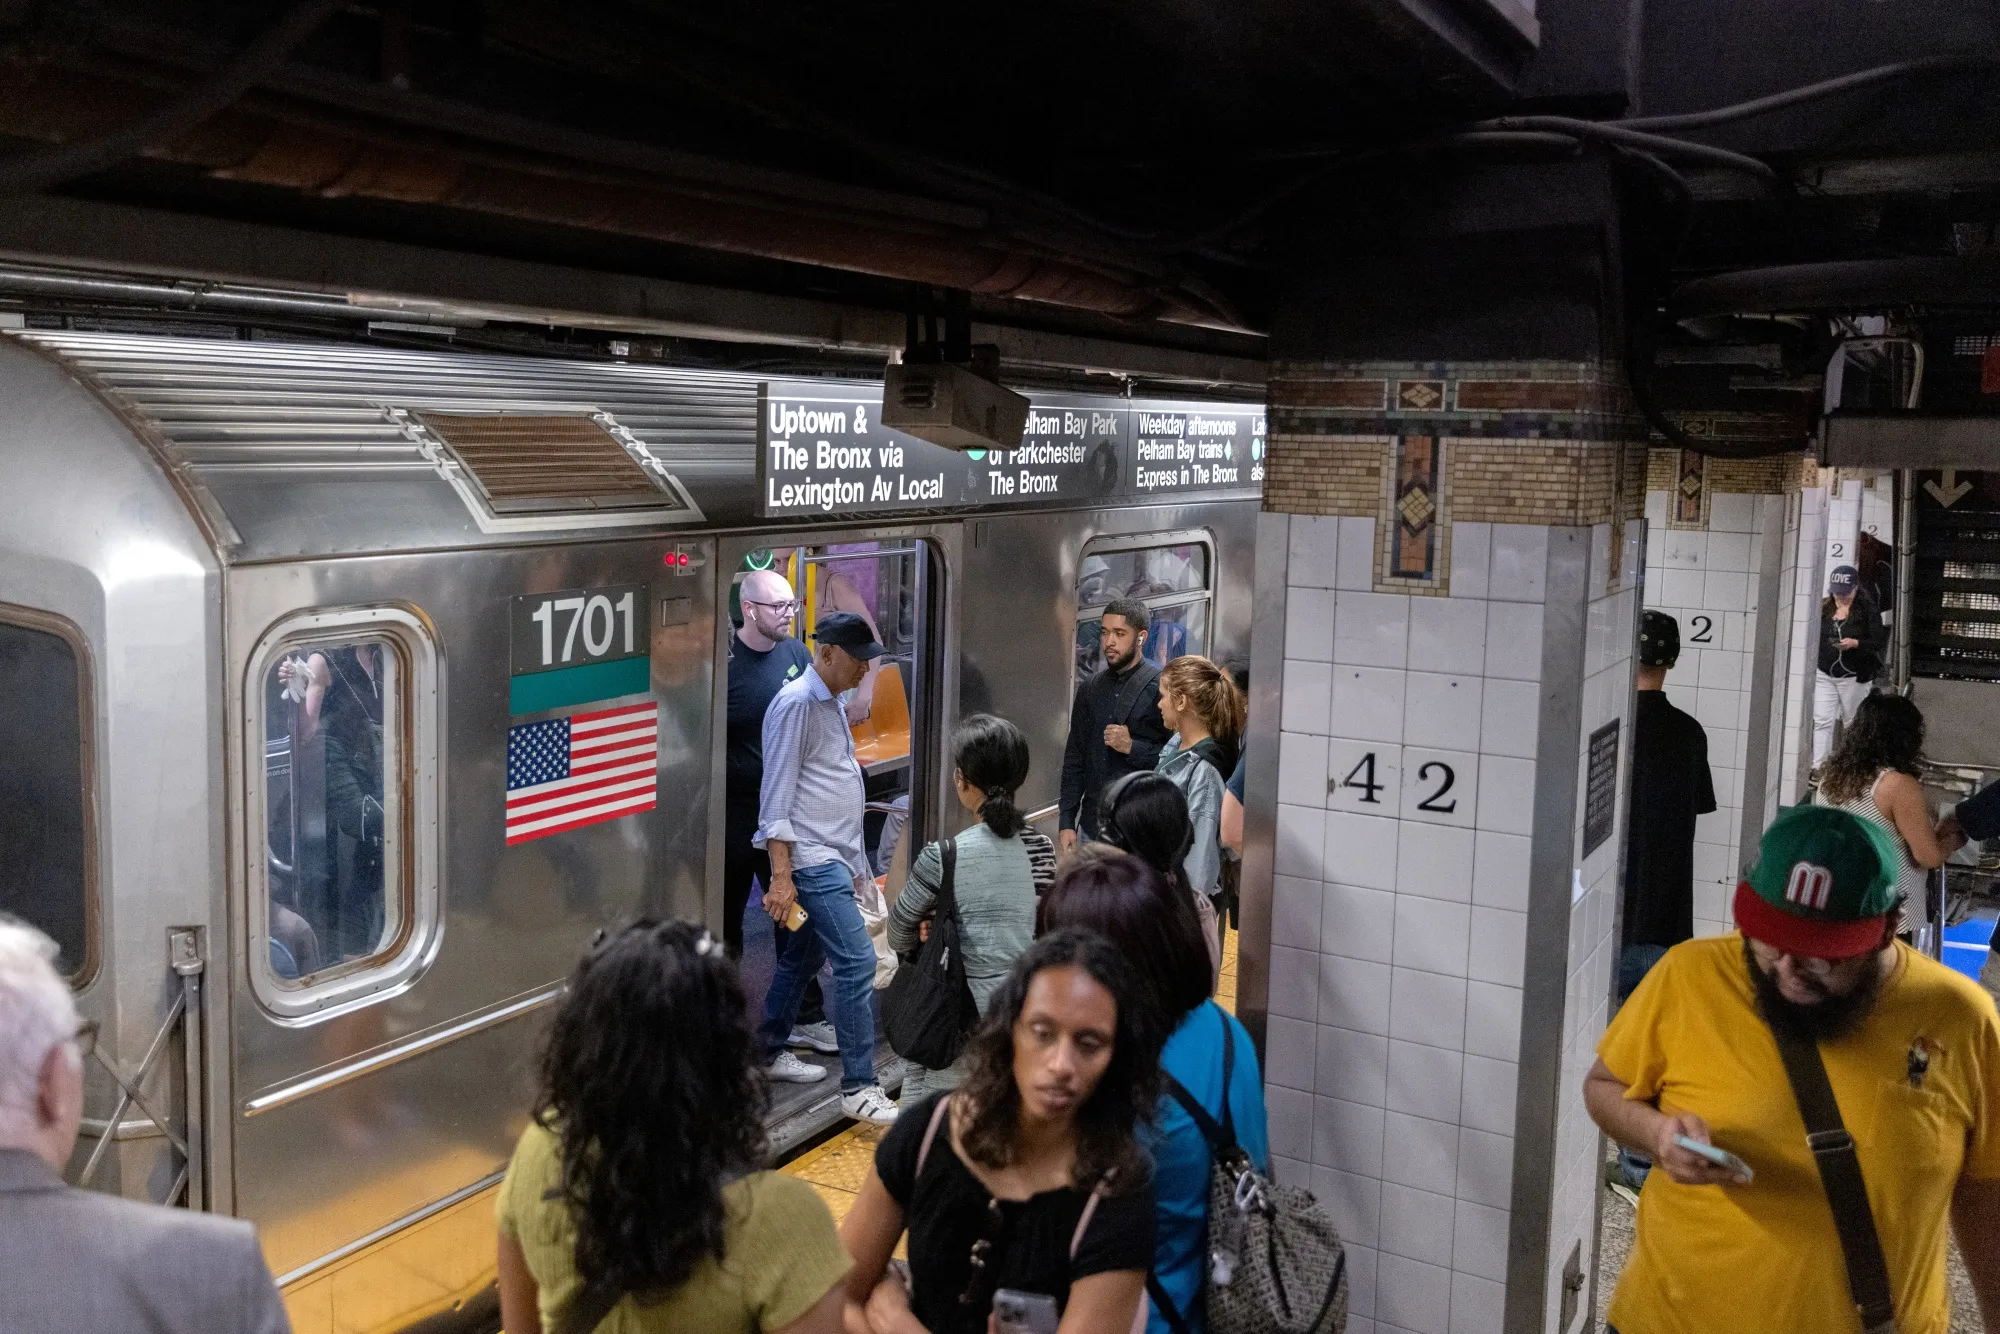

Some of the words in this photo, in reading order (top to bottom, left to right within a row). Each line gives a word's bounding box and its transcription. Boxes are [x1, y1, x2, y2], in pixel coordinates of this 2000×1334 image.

[770, 403, 846, 439] Uptown
[853, 405, 868, 434] &
[1023, 411, 1060, 435] elham
[1064, 412, 1088, 439] Bay
[1091, 412, 1118, 435] Park
[1138, 413, 1186, 439] Weekday
[1188, 416, 1236, 436] afternoons
[1251, 416, 1267, 436] Lat
[770, 440, 809, 470] The
[816, 440, 872, 469] Bronx
[879, 441, 904, 468] via
[1137, 439, 1174, 461] Pelham
[1177, 439, 1196, 463] Bay
[1198, 439, 1224, 459] trains
[988, 471, 1015, 496] The
[1019, 470, 1059, 494] Bronx
[1136, 466, 1178, 491] Express
[1180, 465, 1190, 485] in
[1192, 464, 1210, 485] The
[1212, 463, 1239, 484] Bronx
[1250, 462, 1265, 481] als
[769, 477, 865, 511] Lexington
[870, 475, 893, 502] Av
[898, 473, 944, 500] Local
[1831, 543, 1844, 558] 2
[1831, 573, 1851, 584] LOVE
[532, 591, 634, 666] 1701
[1689, 615, 1713, 644] 2
